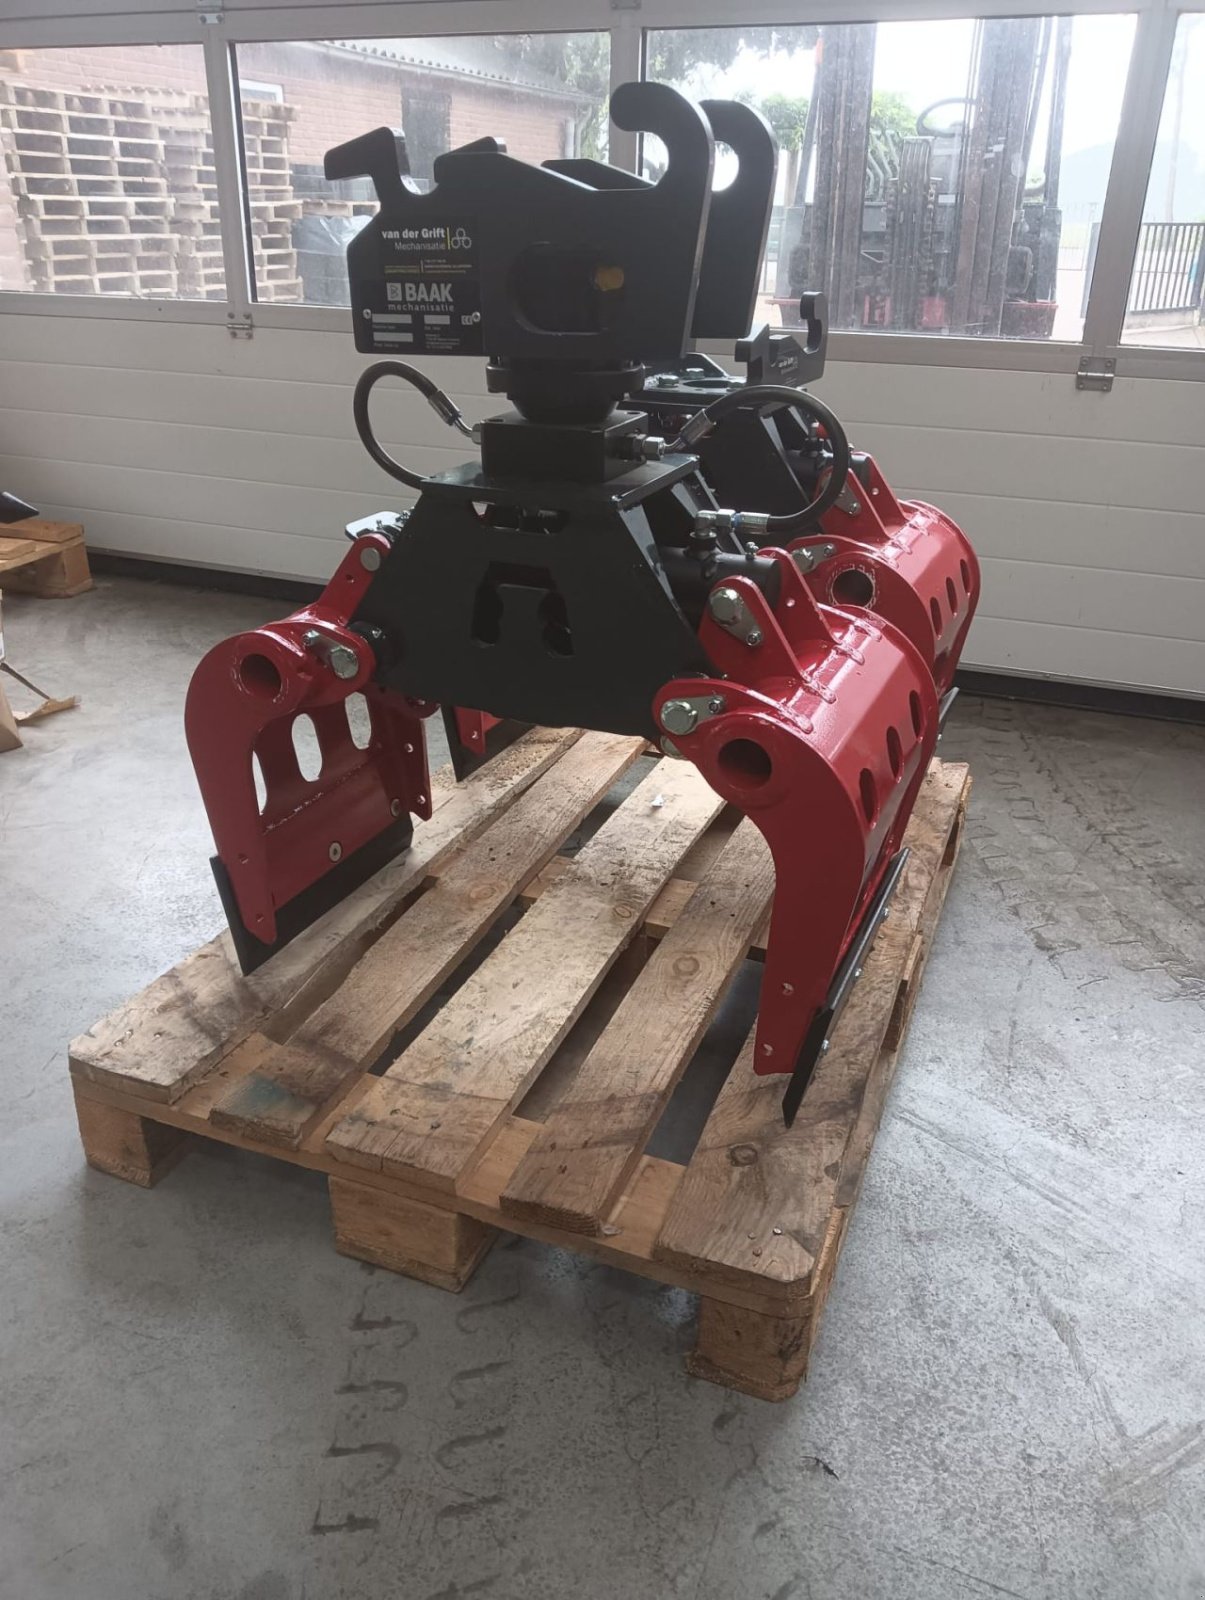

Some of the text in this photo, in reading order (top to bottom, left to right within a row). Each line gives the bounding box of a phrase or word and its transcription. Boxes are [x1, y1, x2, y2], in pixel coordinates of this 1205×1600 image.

[382, 228, 445, 239] van der Grift
[394, 242, 446, 250] Mechanisatie
[404, 283, 454, 302] BAAK
[388, 303, 454, 312] mechanisatie
